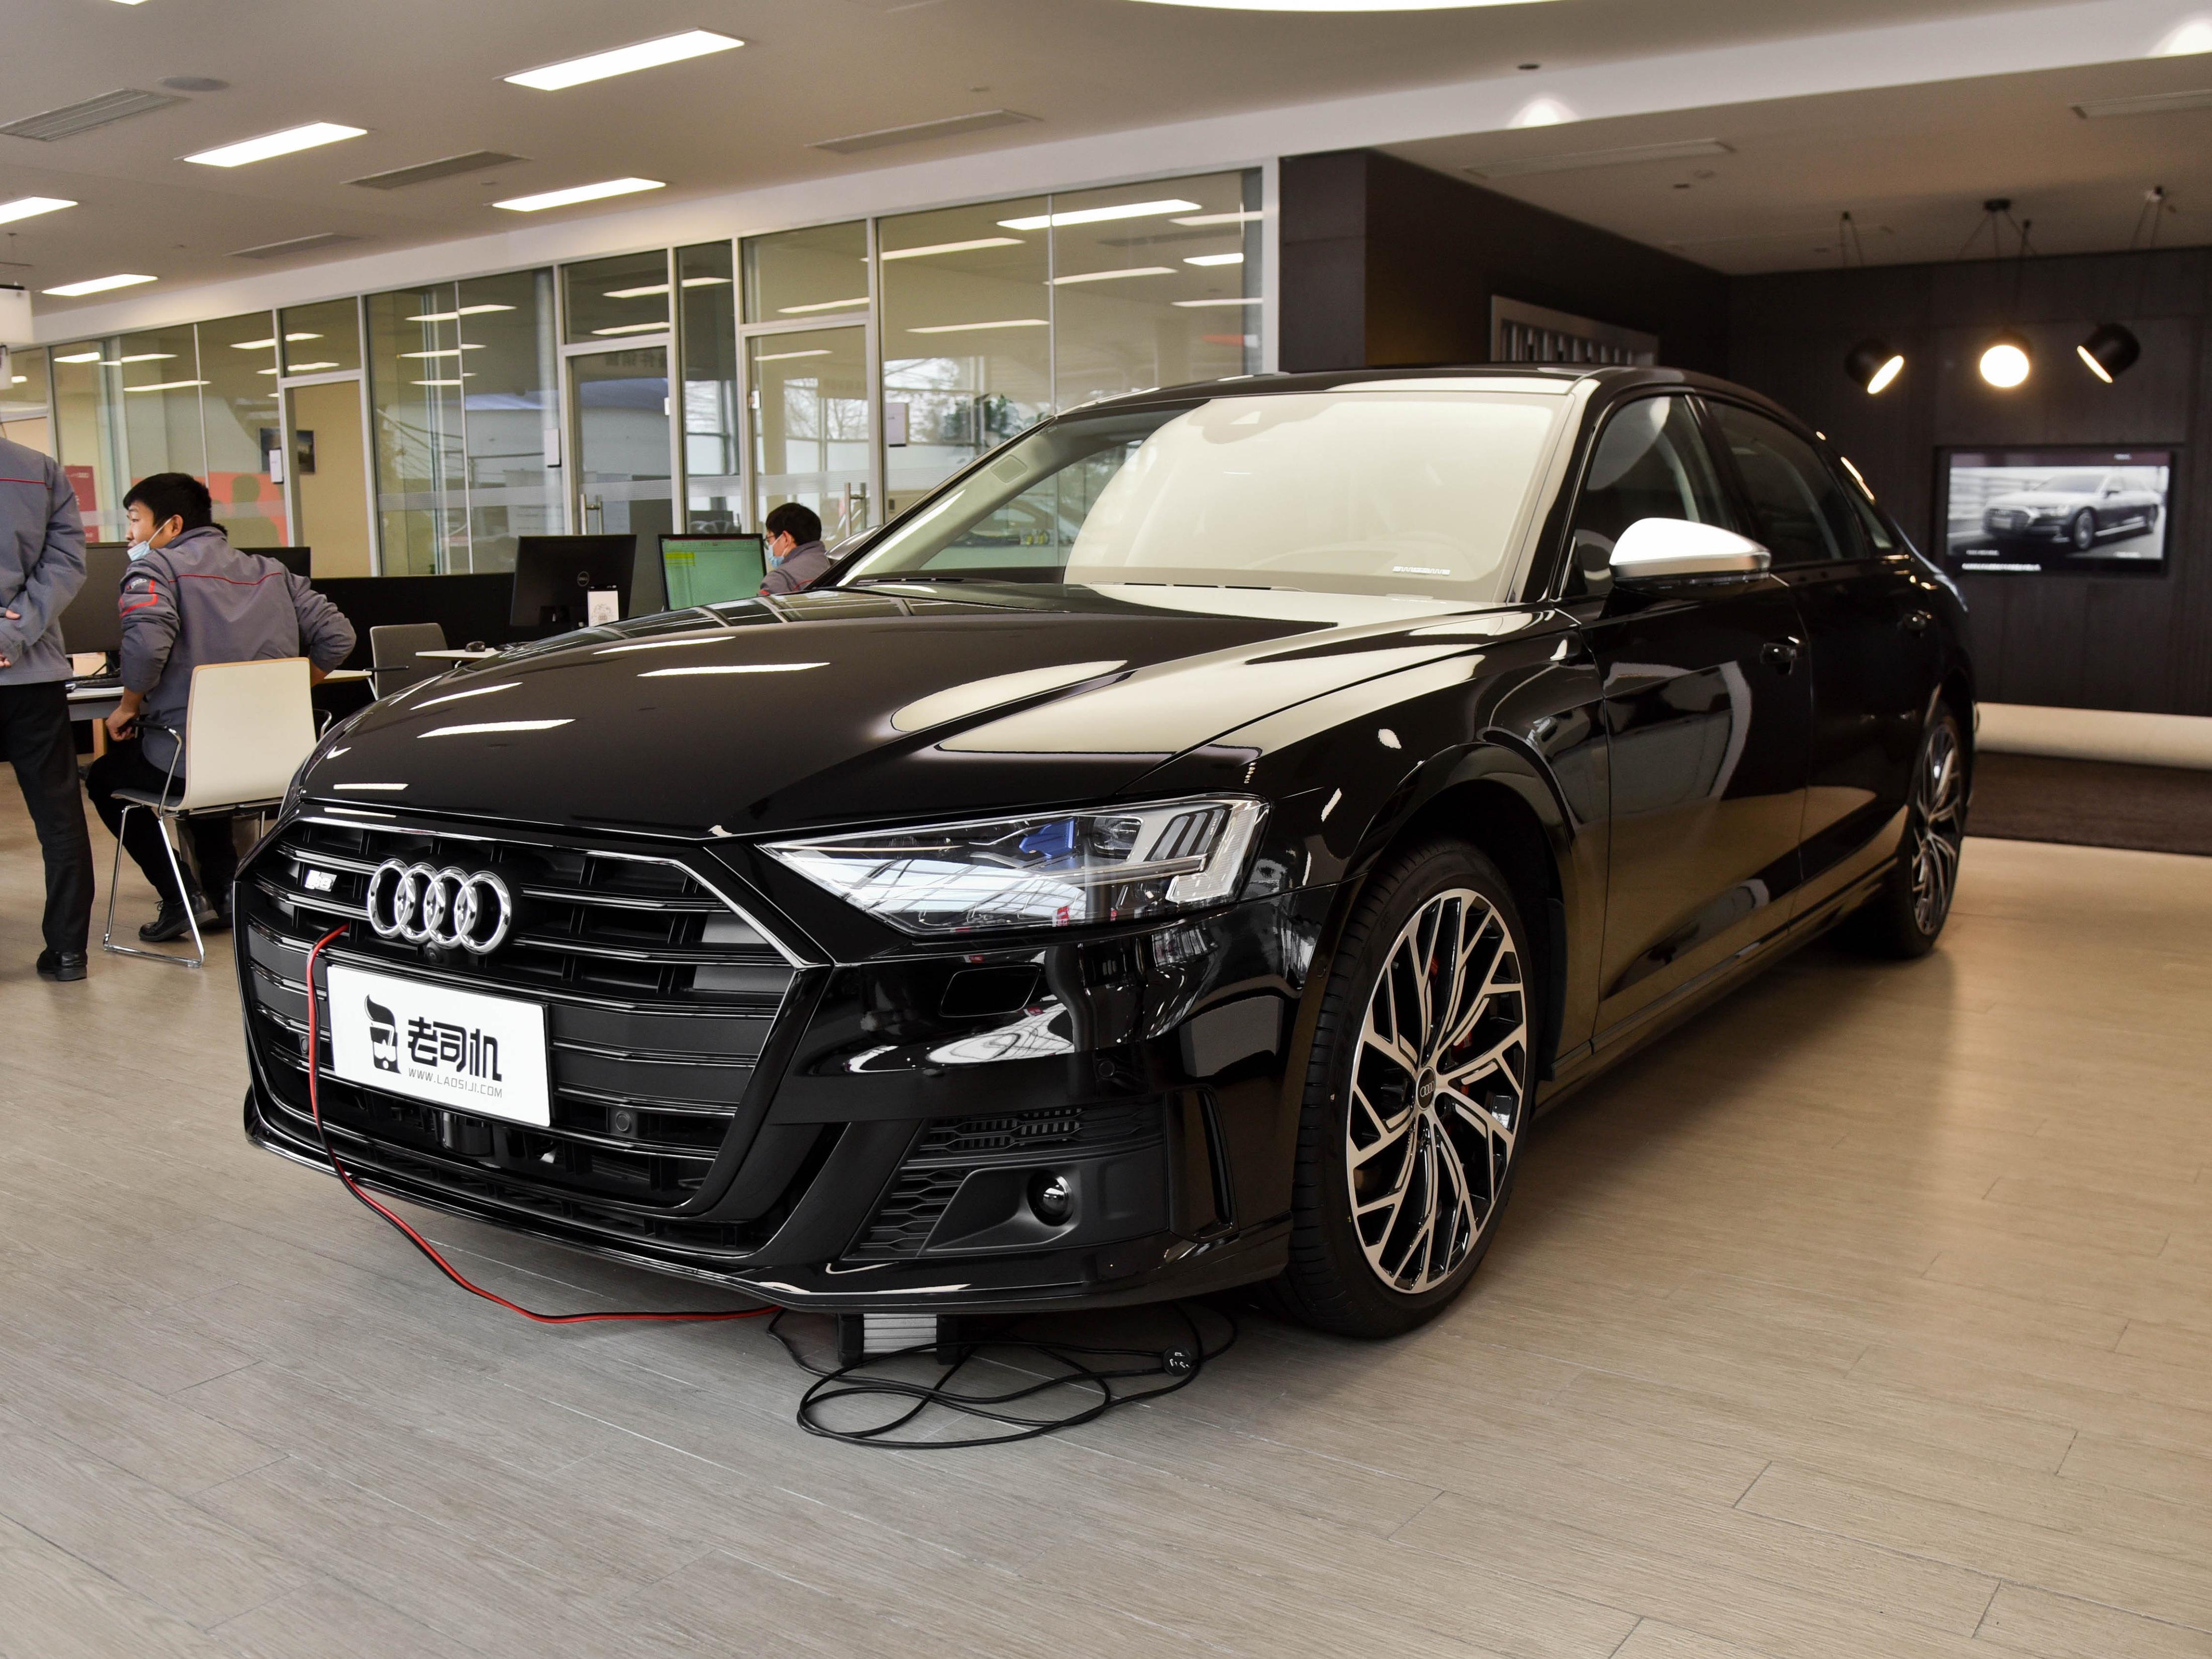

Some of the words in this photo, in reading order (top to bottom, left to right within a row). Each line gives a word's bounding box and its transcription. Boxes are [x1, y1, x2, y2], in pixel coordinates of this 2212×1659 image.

[408, 1017, 503, 1082] 老司机
[408, 1067, 503, 1098] WWW.LAOSIJI.COM
